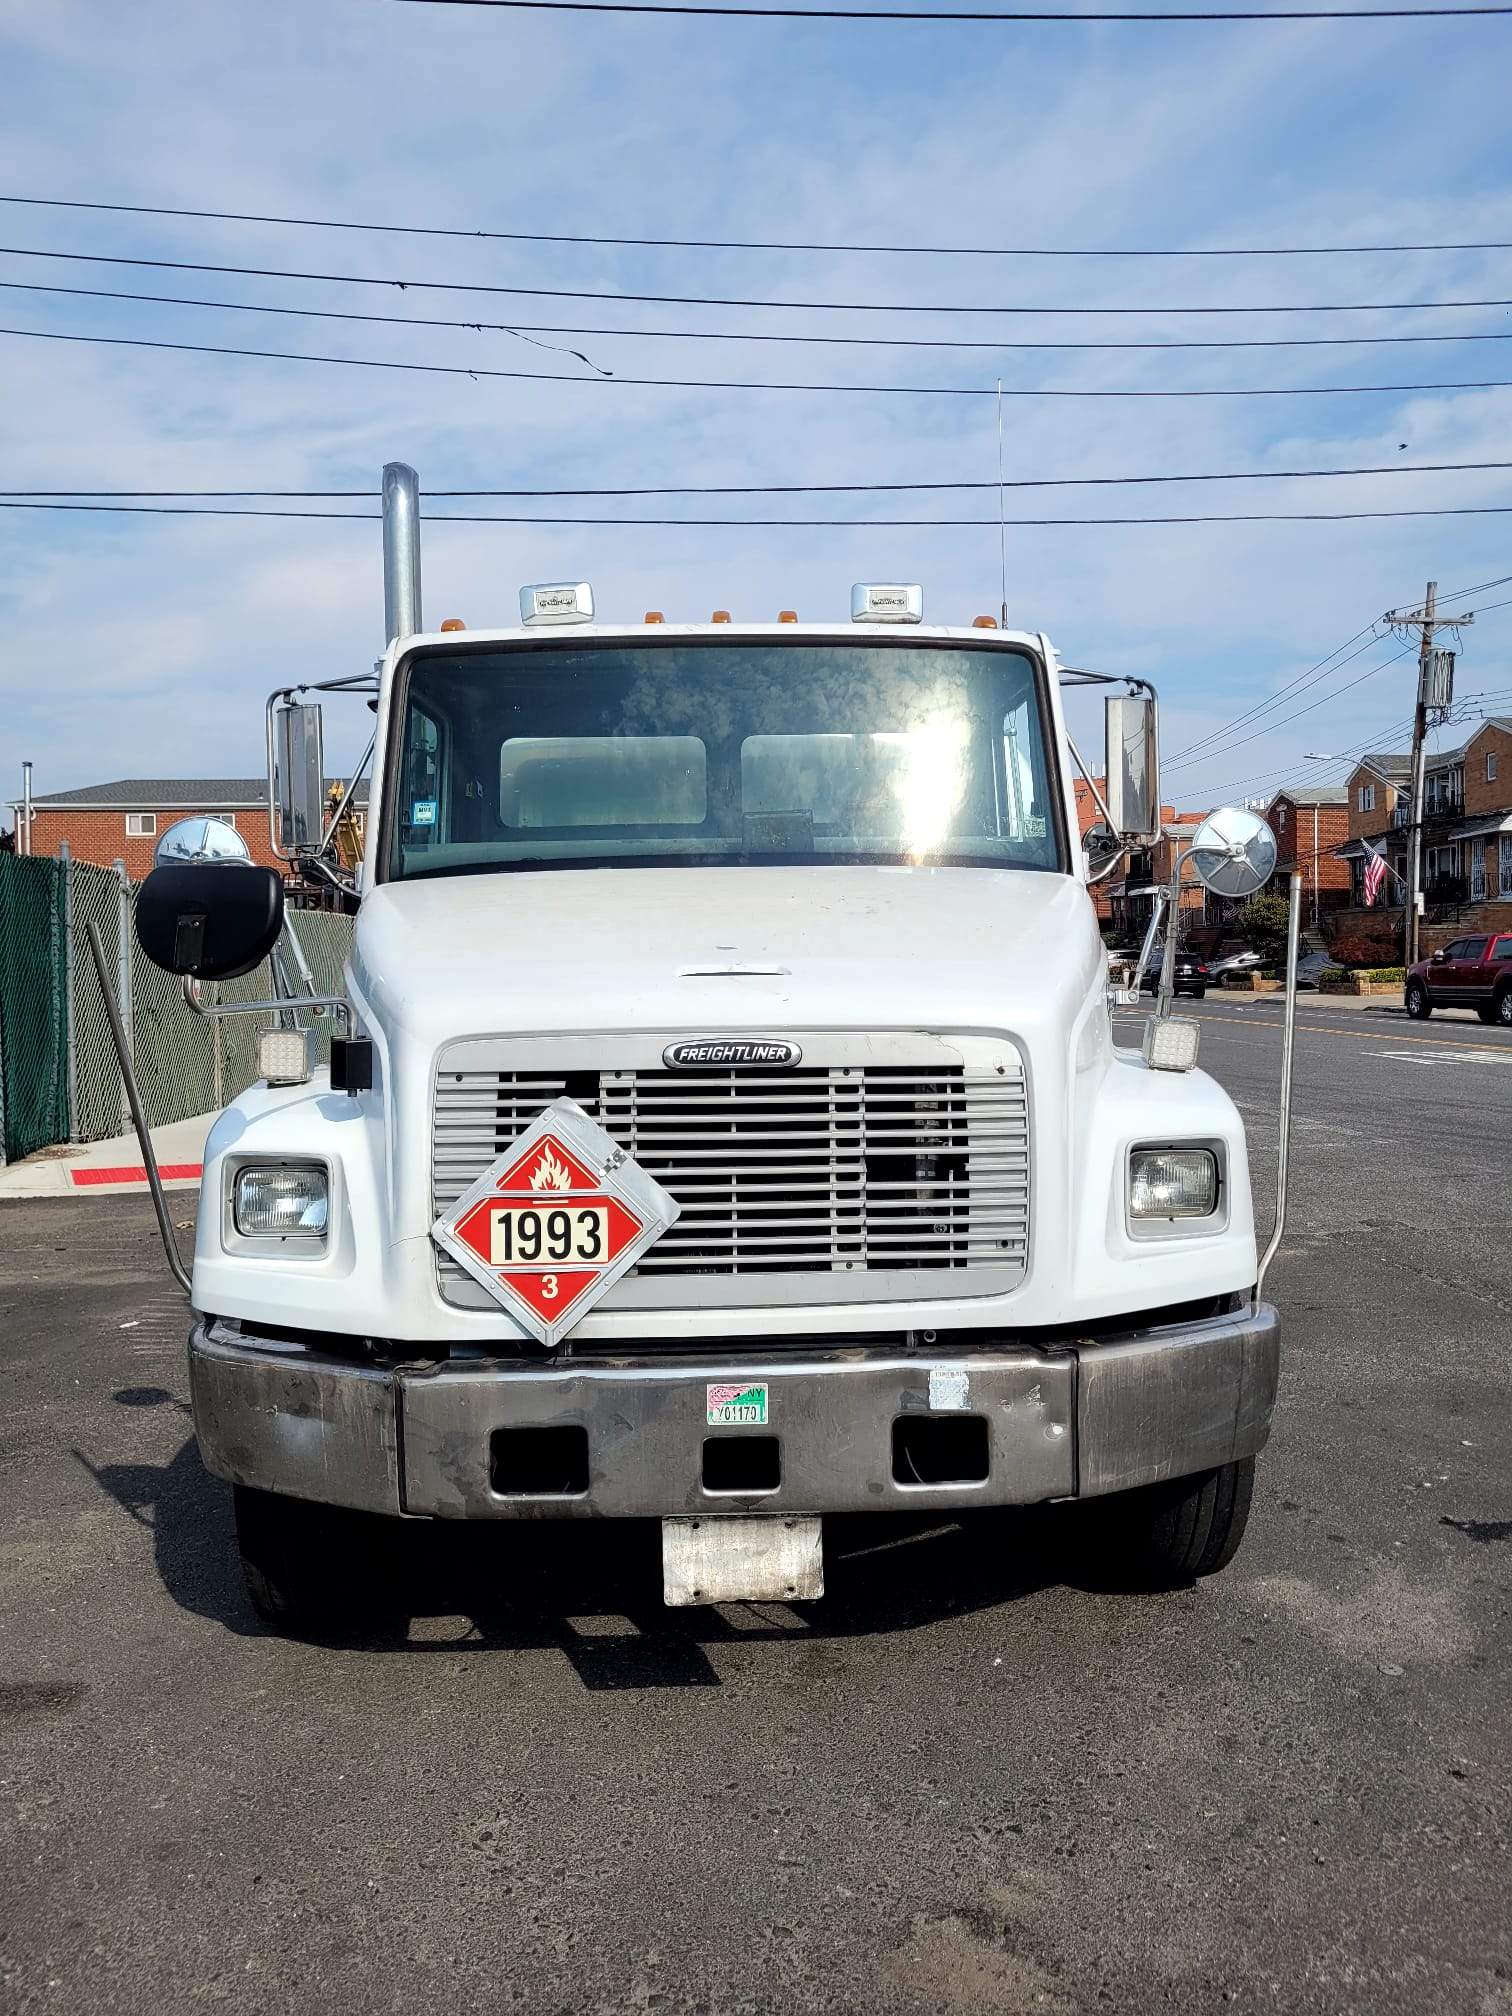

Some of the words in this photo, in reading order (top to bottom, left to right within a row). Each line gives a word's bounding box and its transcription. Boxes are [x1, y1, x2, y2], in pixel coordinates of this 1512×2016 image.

[679, 1046, 787, 1061] FREIGHTLINER
[498, 1210, 601, 1260] 1993
[541, 1274, 559, 1299] 3
[747, 1388, 762, 1397] NY
